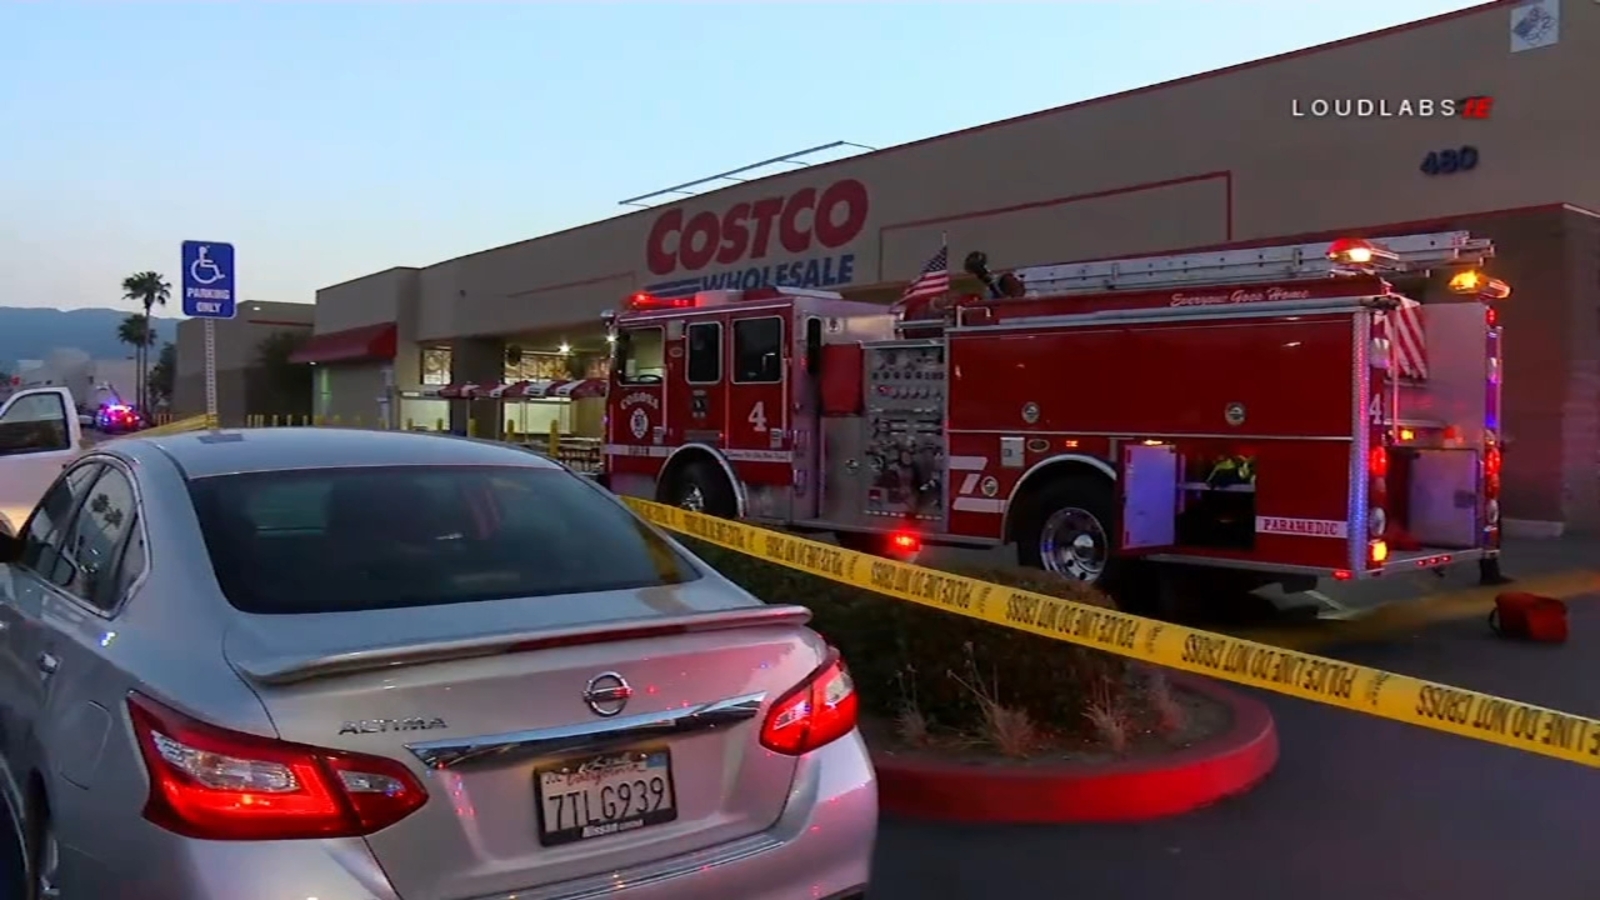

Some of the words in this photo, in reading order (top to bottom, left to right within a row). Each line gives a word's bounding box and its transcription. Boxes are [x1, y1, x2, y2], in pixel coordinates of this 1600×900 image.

[646, 179, 868, 275] COSTCO
[702, 254, 855, 291] WHOLESALE
[187, 287, 230, 299] PARKING
[195, 302, 221, 313] ONLY
[748, 401, 767, 432] 4
[1369, 393, 1382, 424] 4
[1263, 518, 1339, 535] PARAMEDIC
[1097, 613, 1140, 649] POLICE
[1181, 633, 1228, 670] CROSS
[1222, 641, 1255, 676] NOT
[1252, 649, 1276, 680] DO
[1272, 653, 1306, 687] LINE
[1303, 659, 1359, 699] POLICE
[1416, 685, 1474, 725] CROSS
[1473, 697, 1515, 735] NOT
[1511, 705, 1543, 741] DO
[338, 717, 447, 735] ALTIMA
[1542, 712, 1590, 752] LINE
[548, 776, 665, 833] 7TLG939
